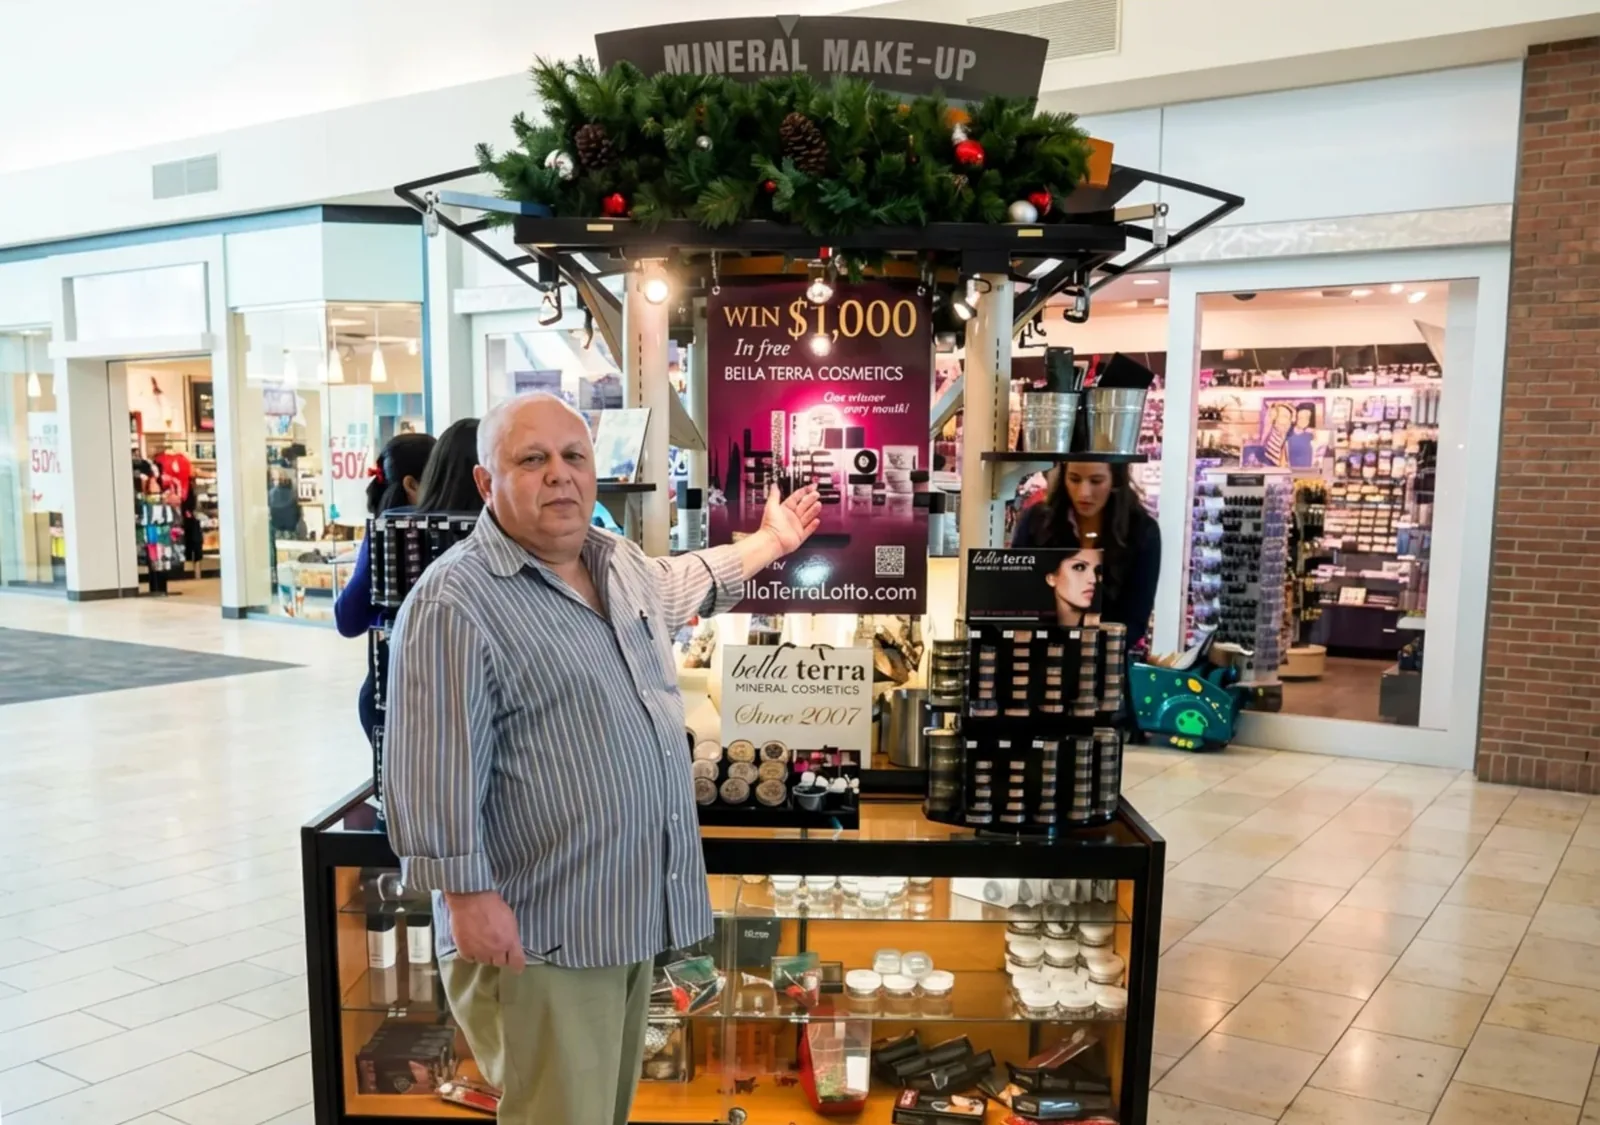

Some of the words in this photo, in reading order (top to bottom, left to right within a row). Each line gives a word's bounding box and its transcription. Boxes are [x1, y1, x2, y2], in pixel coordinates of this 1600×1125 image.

[663, 38, 808, 75] MINERAL
[823, 39, 977, 81] MAKE-UP
[723, 306, 780, 328] WIN
[787, 296, 917, 343] $1,000
[734, 338, 754, 356] In
[754, 338, 791, 362] free
[724, 366, 766, 381] BELLA
[768, 366, 814, 381] TERRA
[817, 365, 904, 381] COSMETICS
[1003, 553, 1036, 565] terra
[731, 652, 790, 680] bella
[796, 659, 866, 681] terra
[735, 683, 789, 694] MINERAL
[791, 684, 860, 696] COSMETICS
[734, 702, 794, 726] Since
[797, 706, 863, 726] 2007
